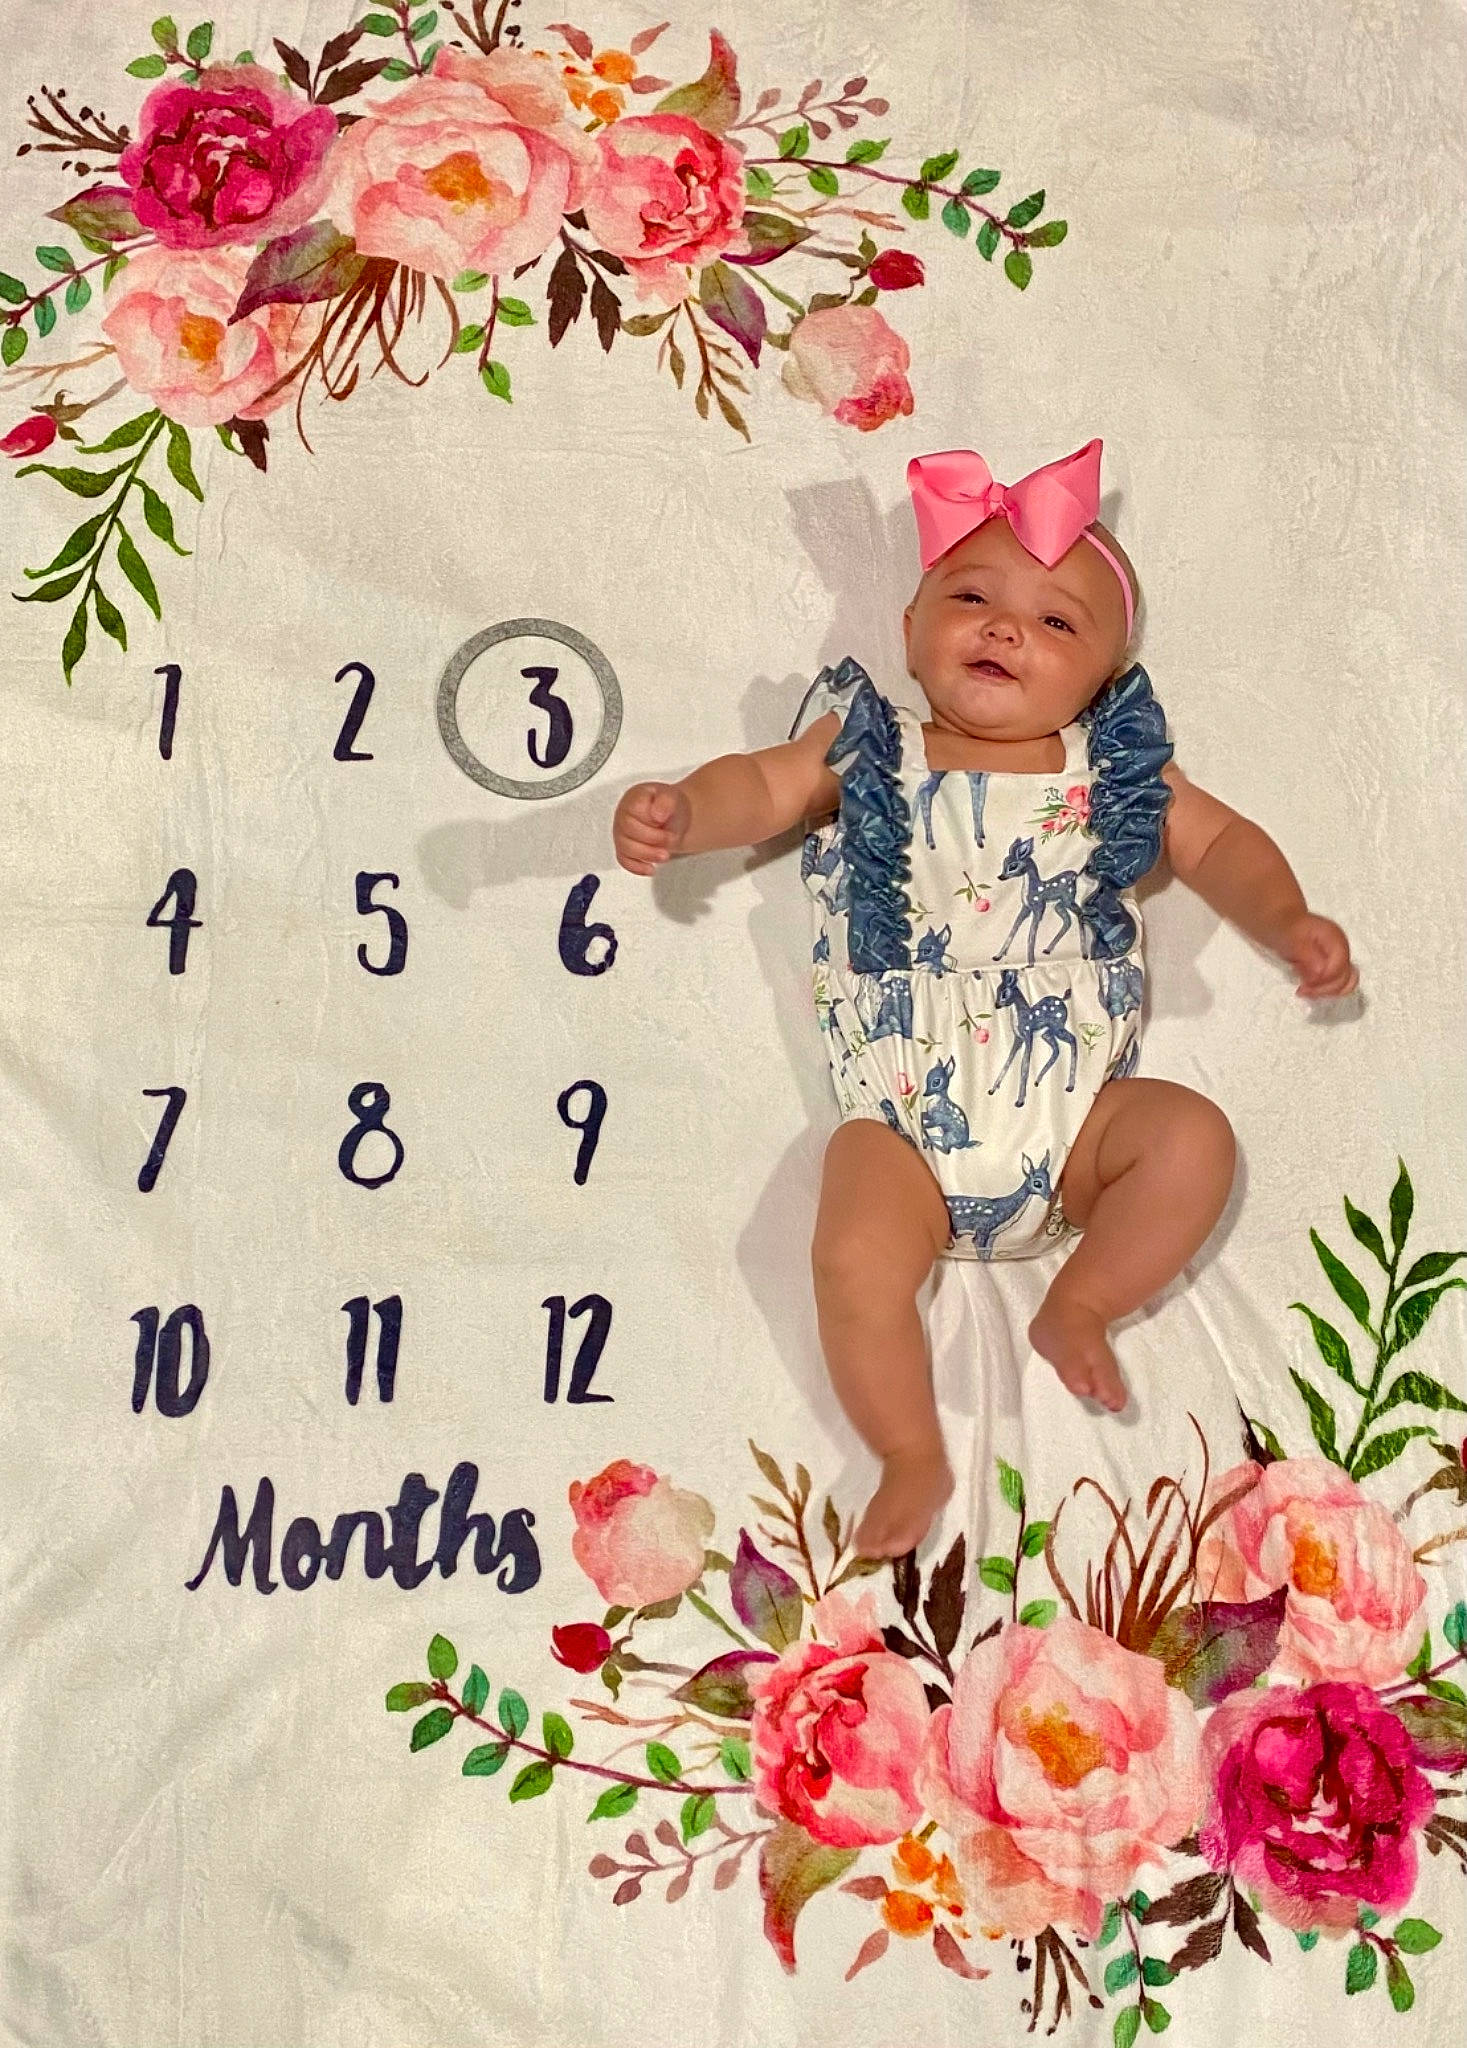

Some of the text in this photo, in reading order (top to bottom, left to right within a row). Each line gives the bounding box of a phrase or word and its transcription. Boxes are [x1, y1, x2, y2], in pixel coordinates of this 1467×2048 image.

[154, 661, 574, 769] 1 2 3
[146, 868, 619, 977] 4 5 6
[137, 1079, 608, 1194] 7 8 9
[129, 1293, 615, 1419] 10 11 12
[184, 1461, 542, 1596] Months
